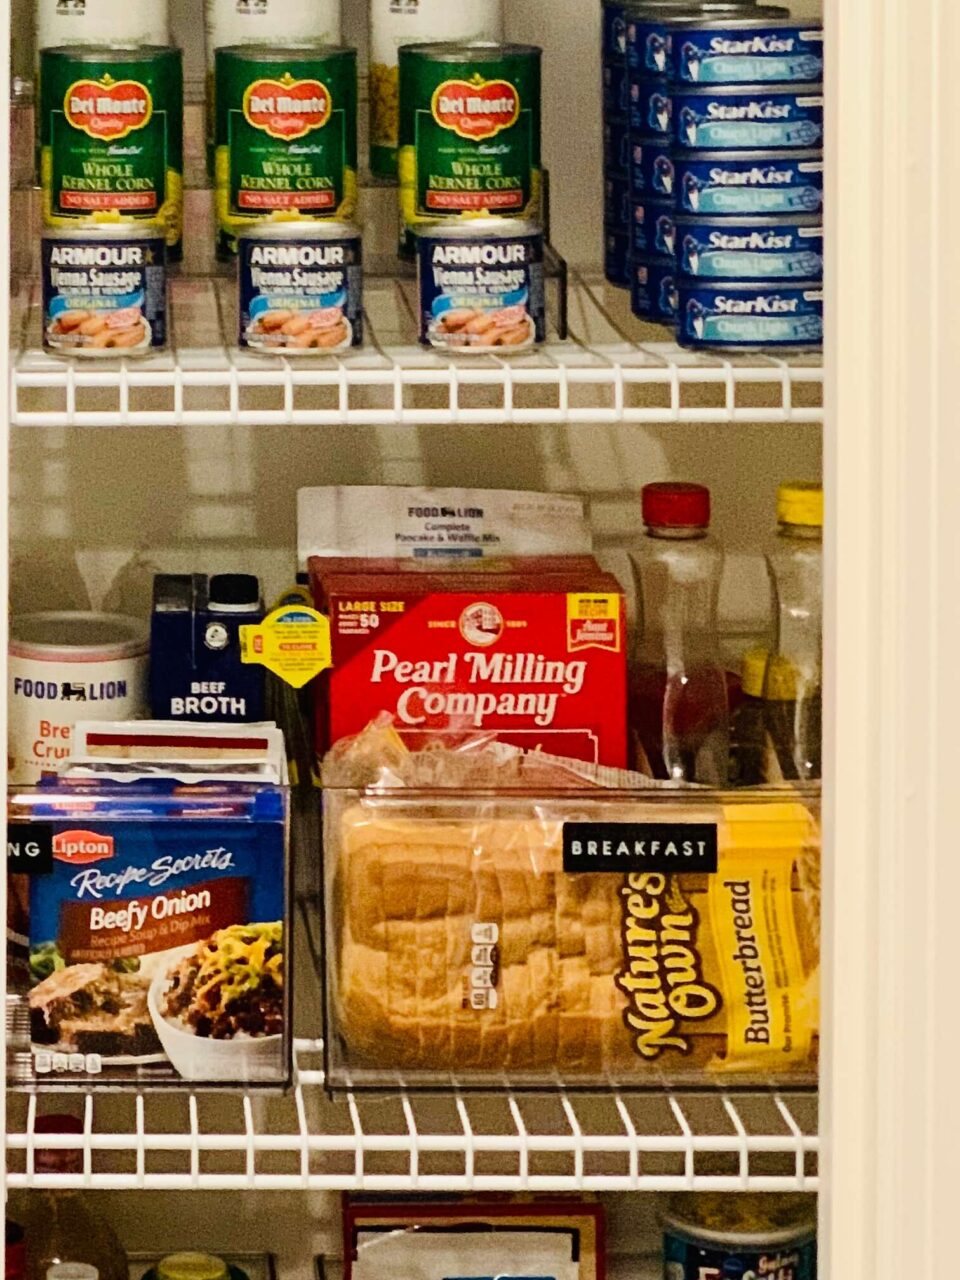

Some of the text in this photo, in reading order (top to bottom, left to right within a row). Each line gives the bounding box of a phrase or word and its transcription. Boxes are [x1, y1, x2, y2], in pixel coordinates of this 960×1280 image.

[710, 36, 794, 54] StarKist
[70, 96, 146, 114] Del Monte
[250, 96, 325, 113] Del Monte
[439, 95, 515, 113] Del Monte
[707, 101, 791, 119] StarKist
[82, 162, 133, 177] WHOLE
[262, 163, 313, 177] WHOLE
[451, 161, 502, 177] WHOLE
[709, 166, 793, 184] StarKist
[62, 175, 155, 191] KERNEL CORN
[240, 174, 334, 190] KERNEL CORN
[429, 175, 522, 191] KERNEL CORN
[709, 231, 793, 249] StarKist
[50, 247, 143, 265] ARMOUR
[250, 246, 344, 265] ARMOUR
[433, 245, 525, 264] ARMOUR
[714, 295, 798, 313] StarKist
[408, 507, 484, 518] FOOD LION
[425, 522, 470, 532] Complete
[338, 601, 405, 612] LARGE SIZE
[370, 649, 458, 684] Pearl
[464, 651, 587, 694] Milling
[14, 677, 127, 700] FOOD LION
[191, 682, 225, 695] BEEF
[170, 697, 246, 716] BROTH
[396, 686, 558, 726] Company
[40, 720, 70, 739] Bre
[32, 740, 70, 759] Cru
[53, 835, 110, 856] Lipton
[571, 840, 707, 858] BREAKFAST
[70, 846, 236, 899] Recipe Secrets
[90, 888, 211, 933] Beefy Onion
[90, 915, 211, 947] Recipe Soup & Dip Mix
[621, 871, 688, 1058] Nature's
[660, 912, 719, 1017] Own
[724, 879, 771, 1046] Butterbread
